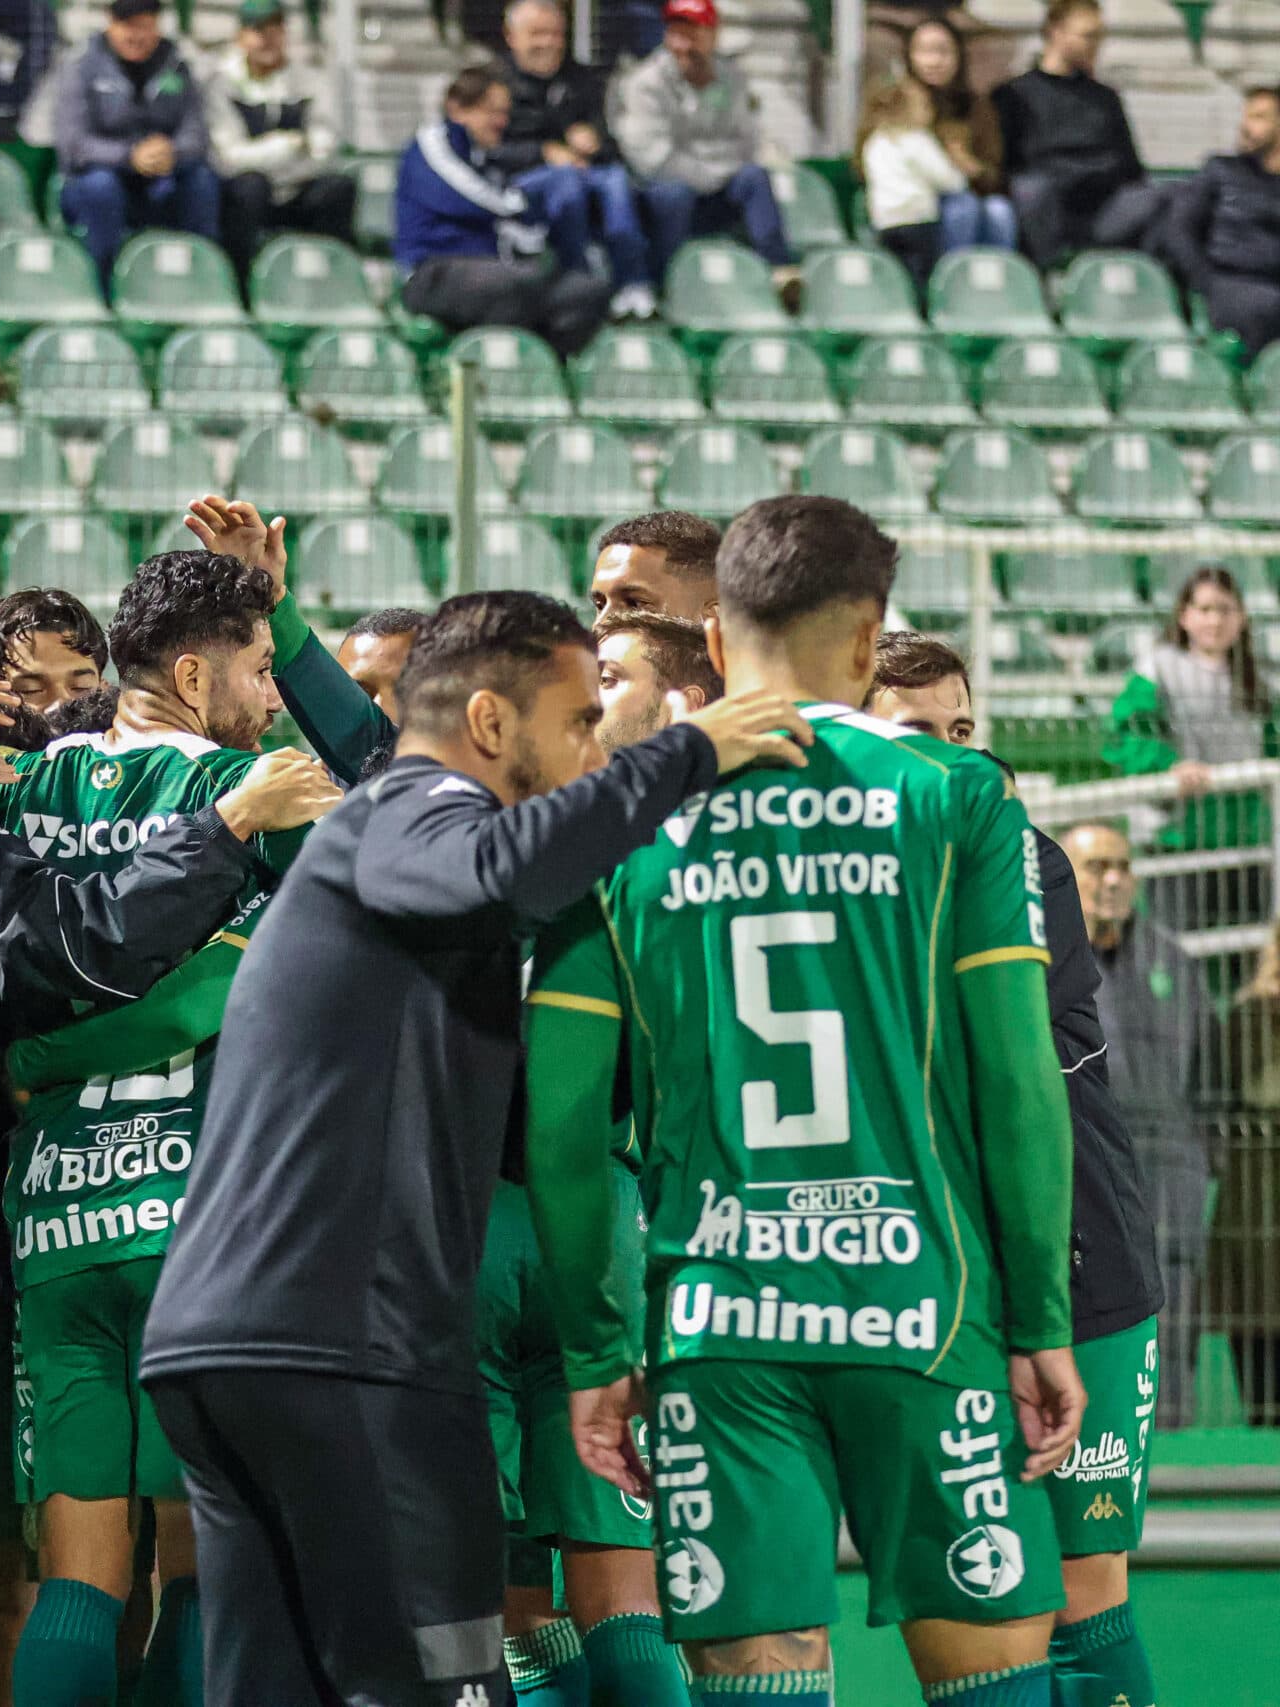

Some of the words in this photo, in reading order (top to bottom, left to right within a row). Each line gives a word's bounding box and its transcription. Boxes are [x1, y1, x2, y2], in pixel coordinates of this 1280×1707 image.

[57, 813, 179, 858] SICOO
[709, 786, 899, 833] SICOOB
[661, 850, 770, 911] JOÃO
[776, 852, 900, 897] VITOR
[730, 911, 850, 1149] 5
[95, 1116, 159, 1146] GRUPO
[57, 1137, 193, 1192] BUGIO
[787, 1183, 879, 1211] GRUPO
[745, 1214, 921, 1265] BUGIO
[670, 1282, 938, 1350] Unimed
[656, 1392, 713, 1531] alfa
[940, 1388, 1009, 1519] alfa
[1075, 1471, 1103, 1483] PURO
